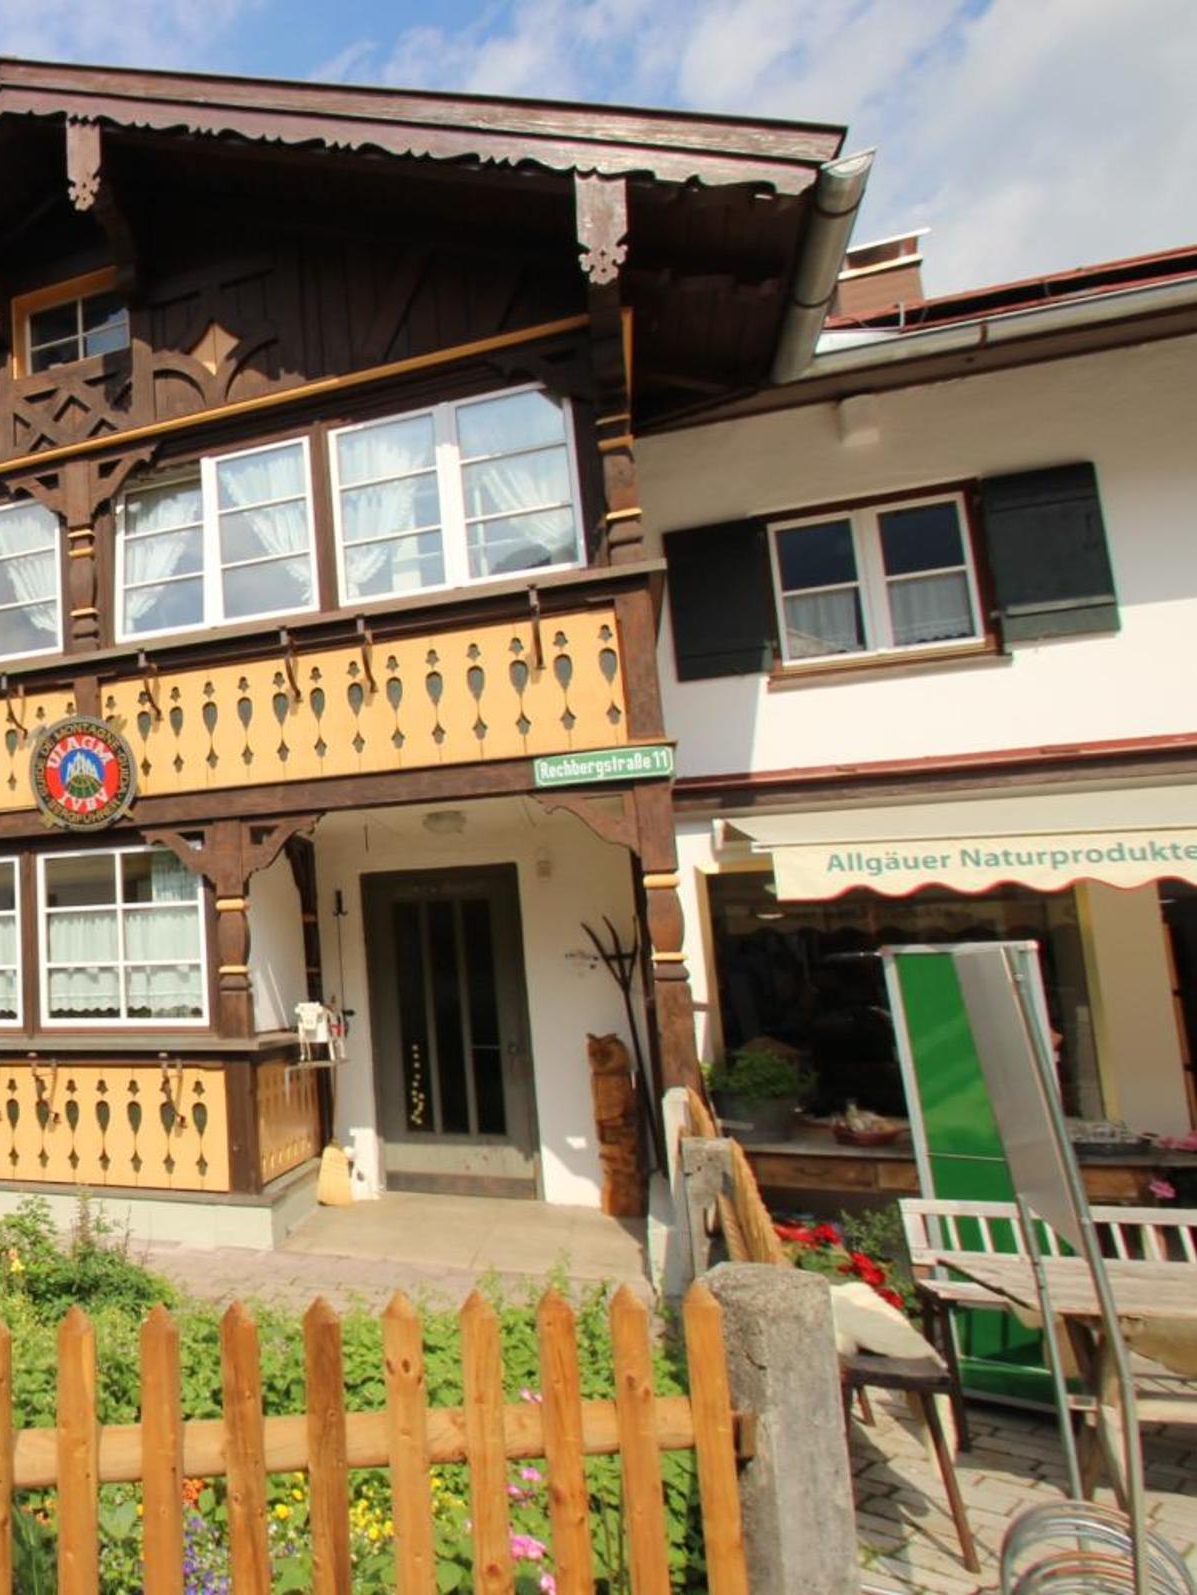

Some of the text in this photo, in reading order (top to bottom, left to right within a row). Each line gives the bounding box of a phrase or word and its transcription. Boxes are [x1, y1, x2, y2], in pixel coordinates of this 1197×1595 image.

[48, 735, 115, 767] UIAGM
[540, 750, 668, 779] Rechbergstraße 11
[826, 841, 1197, 876] Allgäuer Naturprodukte
